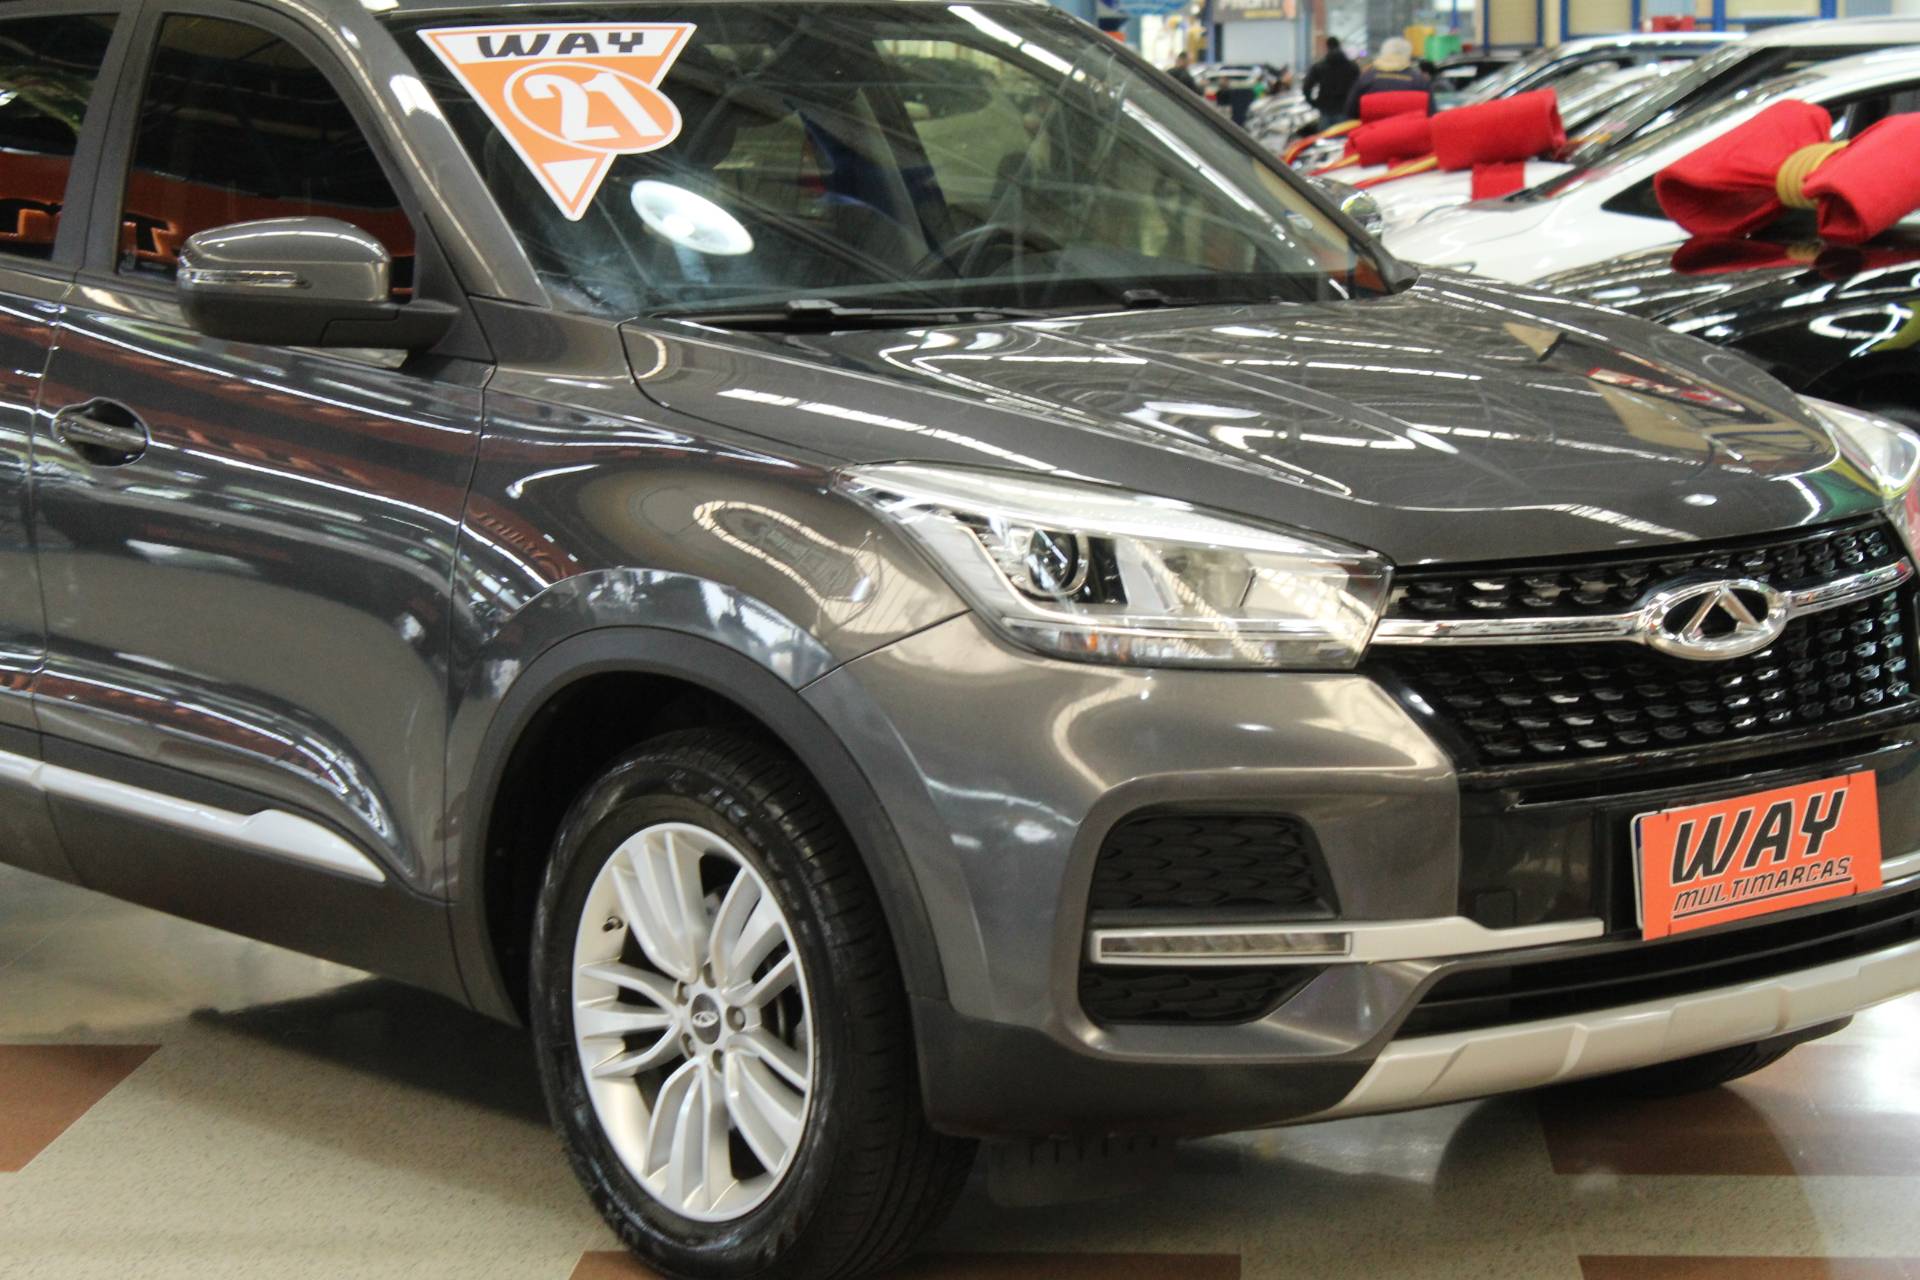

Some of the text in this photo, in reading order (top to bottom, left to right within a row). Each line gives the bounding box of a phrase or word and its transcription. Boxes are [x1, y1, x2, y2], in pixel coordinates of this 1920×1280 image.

[477, 32, 644, 58] WAY
[523, 72, 665, 141] 21
[1670, 787, 1849, 886] WAY
[1672, 856, 1852, 912] MULTIMARCAS
